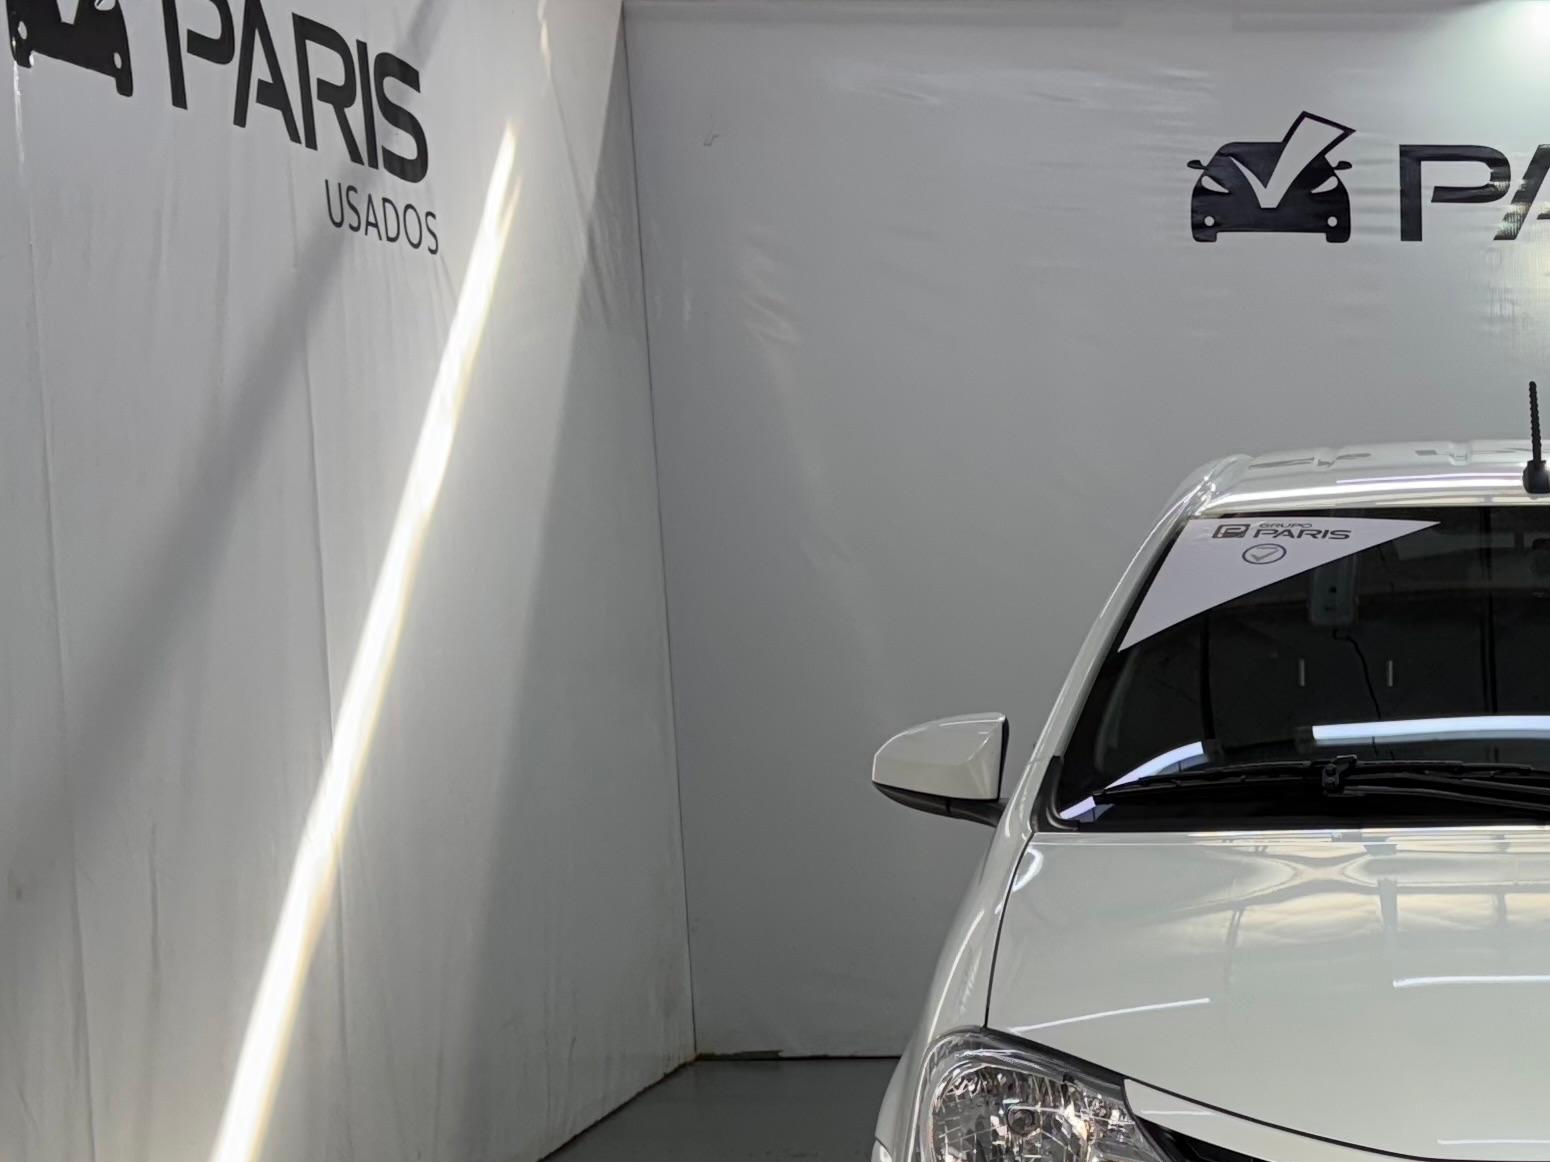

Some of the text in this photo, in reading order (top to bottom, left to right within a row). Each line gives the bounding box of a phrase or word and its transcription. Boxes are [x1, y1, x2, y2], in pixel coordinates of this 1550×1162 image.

[161, 0, 429, 184] PARIS
[324, 178, 440, 256] USADOS
[1253, 528, 1352, 540] PARIS
